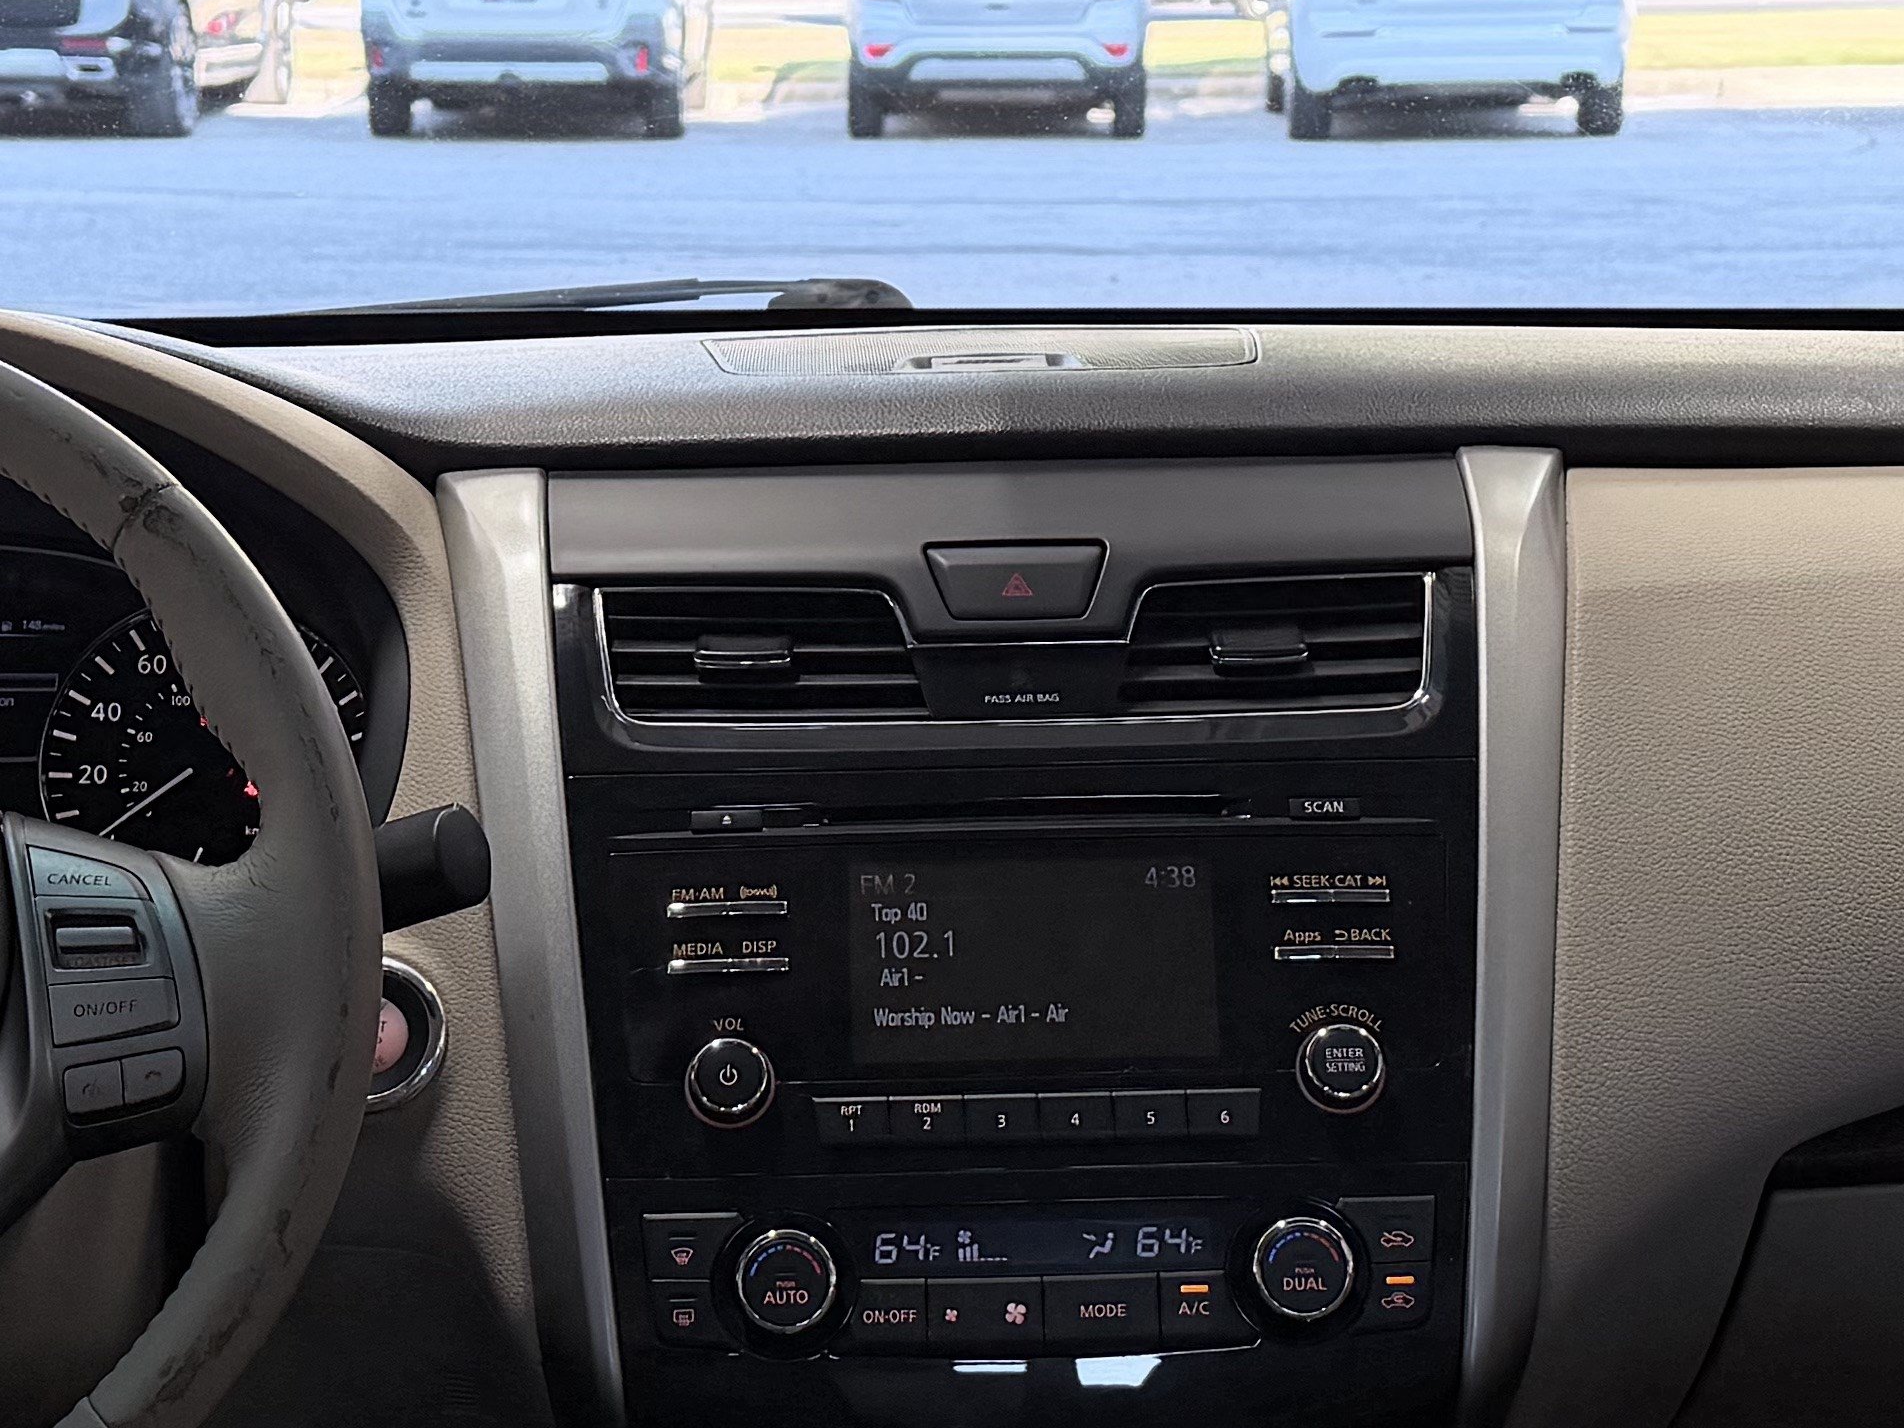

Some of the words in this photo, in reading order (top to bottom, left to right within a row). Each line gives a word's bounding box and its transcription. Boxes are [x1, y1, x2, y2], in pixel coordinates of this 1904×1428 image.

[138, 655, 167, 674] 60
[171, 695, 191, 706] 100
[984, 694, 1012, 703] PASS
[1014, 693, 1034, 703] AIR
[1036, 692, 1060, 702] BAG
[91, 703, 122, 722] 40
[137, 732, 153, 743] 60
[78, 765, 108, 785] 20
[132, 781, 148, 792] 20
[1303, 801, 1345, 814] SCAN
[47, 874, 112, 887] CANCEL
[860, 875, 895, 895] FM
[903, 874, 917, 894] 2
[1144, 866, 1197, 890] 4:38
[871, 903, 902, 925] Top
[907, 902, 928, 921] 40
[1284, 928, 1322, 943] Apps
[1350, 927, 1391, 941] BACK
[673, 942, 723, 959] MEDIA
[742, 940, 777, 954] DISP
[876, 930, 957, 959] 102.1
[881, 967, 909, 987] Air1
[73, 999, 137, 1018] ON/OFF
[874, 1008, 935, 1029] Worship
[941, 1007, 976, 1026] Now
[996, 1004, 1026, 1024] Air1
[1045, 1003, 1069, 1023] Air
[713, 1018, 744, 1031] VOL
[1325, 1047, 1364, 1059] ENTER
[841, 1105, 862, 1116] RPT
[914, 1103, 941, 1113] RDM
[923, 1117, 932, 1130] 2
[998, 1115, 1006, 1128] 3
[1071, 1112, 1081, 1126] 4
[1147, 1111, 1155, 1125] 5
[1221, 1110, 1230, 1124] 6
[1283, 1277, 1327, 1291] DUAL
[763, 1290, 808, 1304] AUTO
[1080, 1303, 1127, 1318] MODE
[1178, 1300, 1210, 1316] A/C
